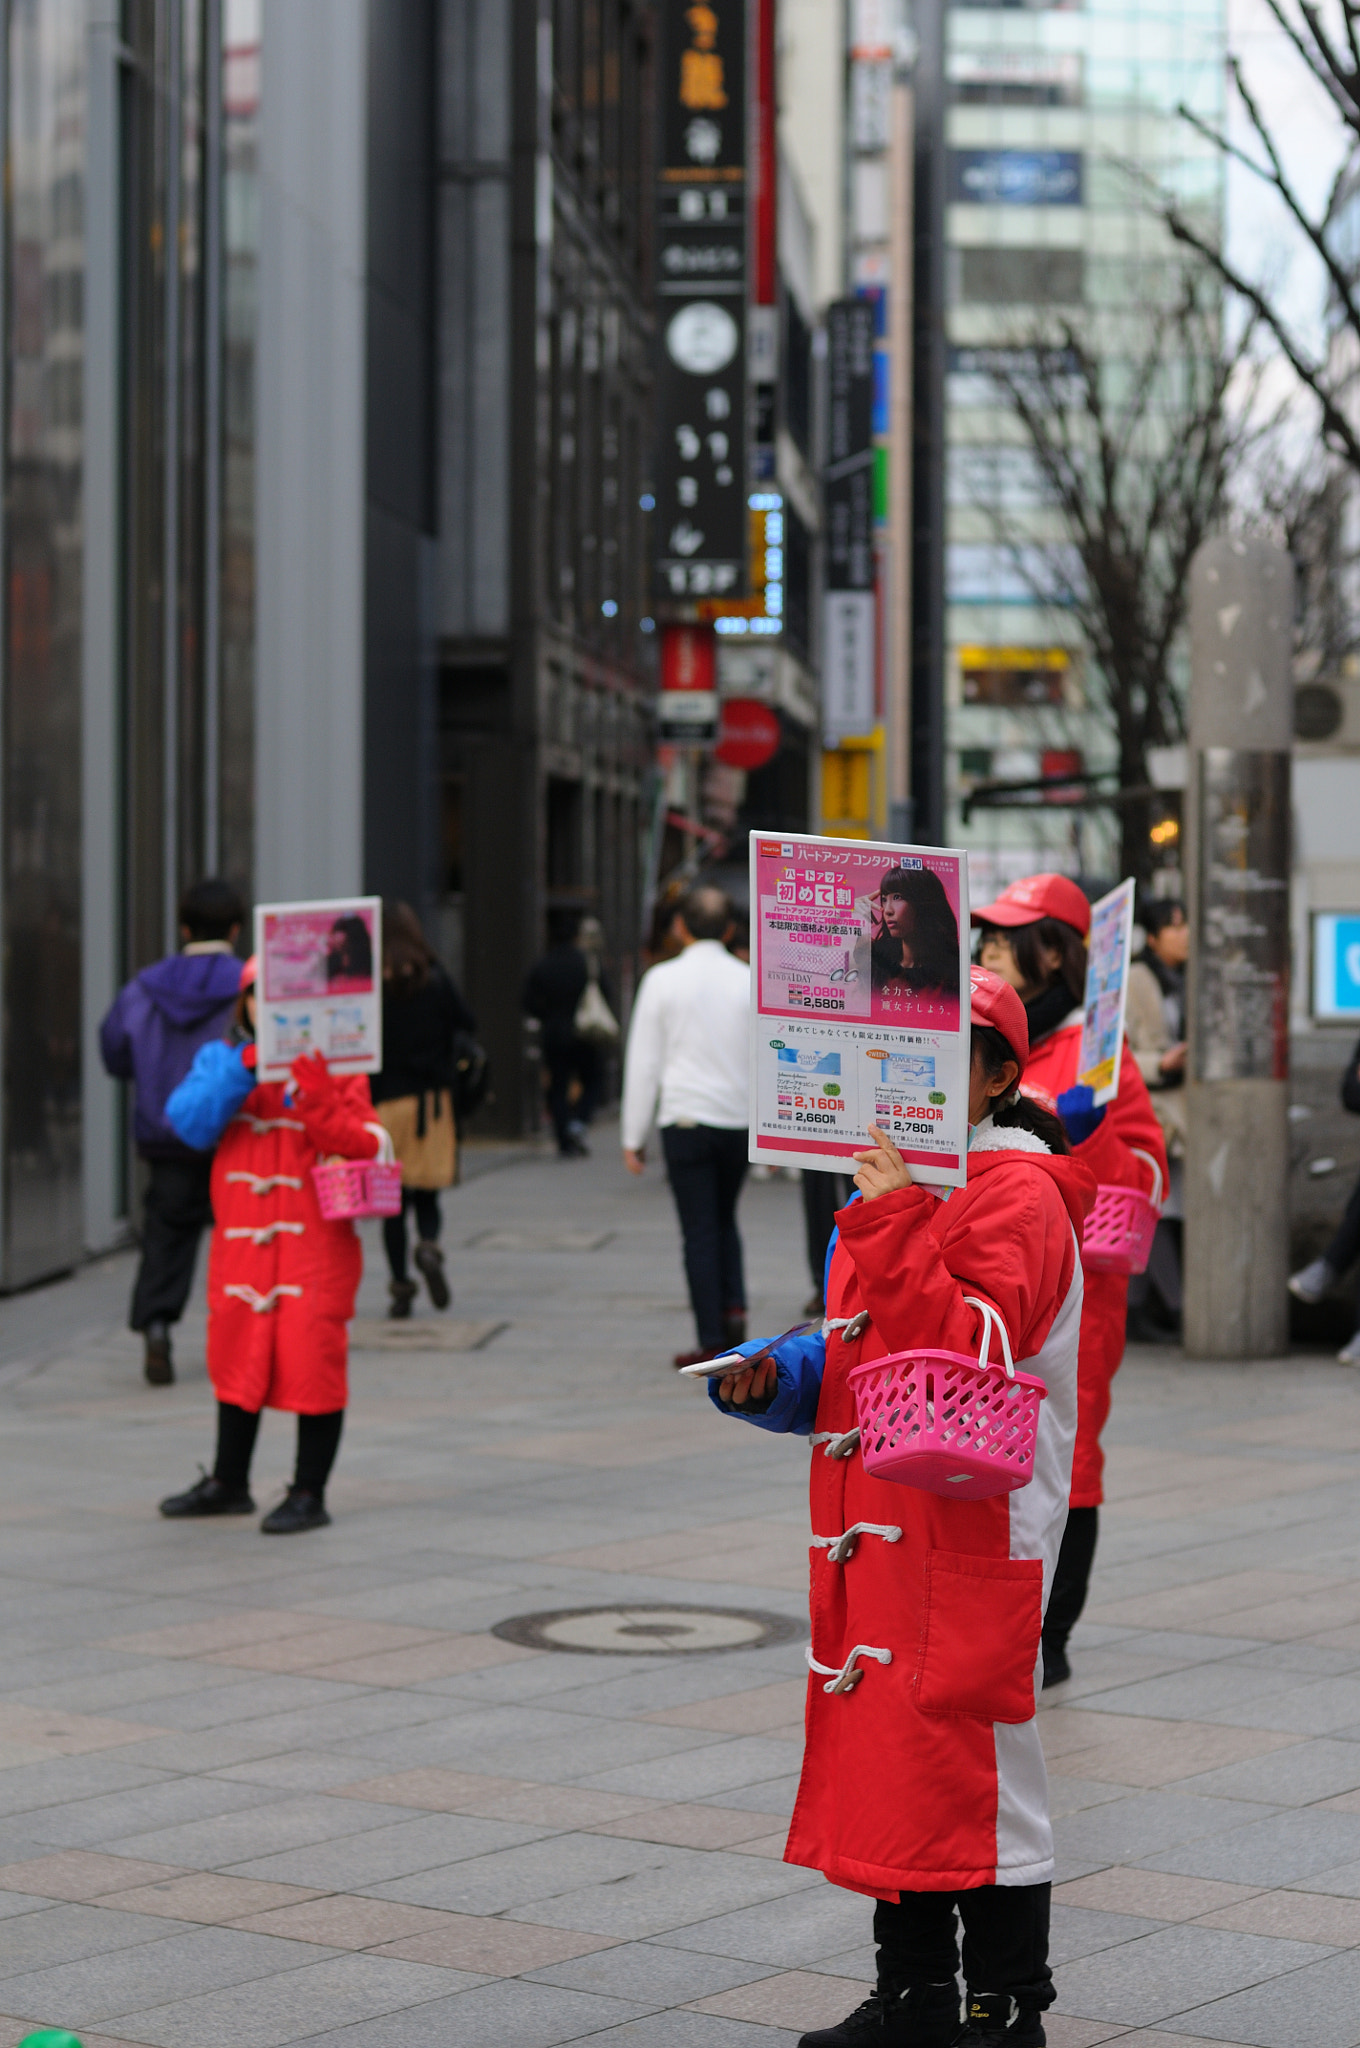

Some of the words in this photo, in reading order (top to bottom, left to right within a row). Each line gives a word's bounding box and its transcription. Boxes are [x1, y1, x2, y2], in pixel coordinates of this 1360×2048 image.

[786, 870, 844, 882] ハートアップ
[778, 883, 852, 905] 初めて割
[789, 932, 842, 947] 500円引き
